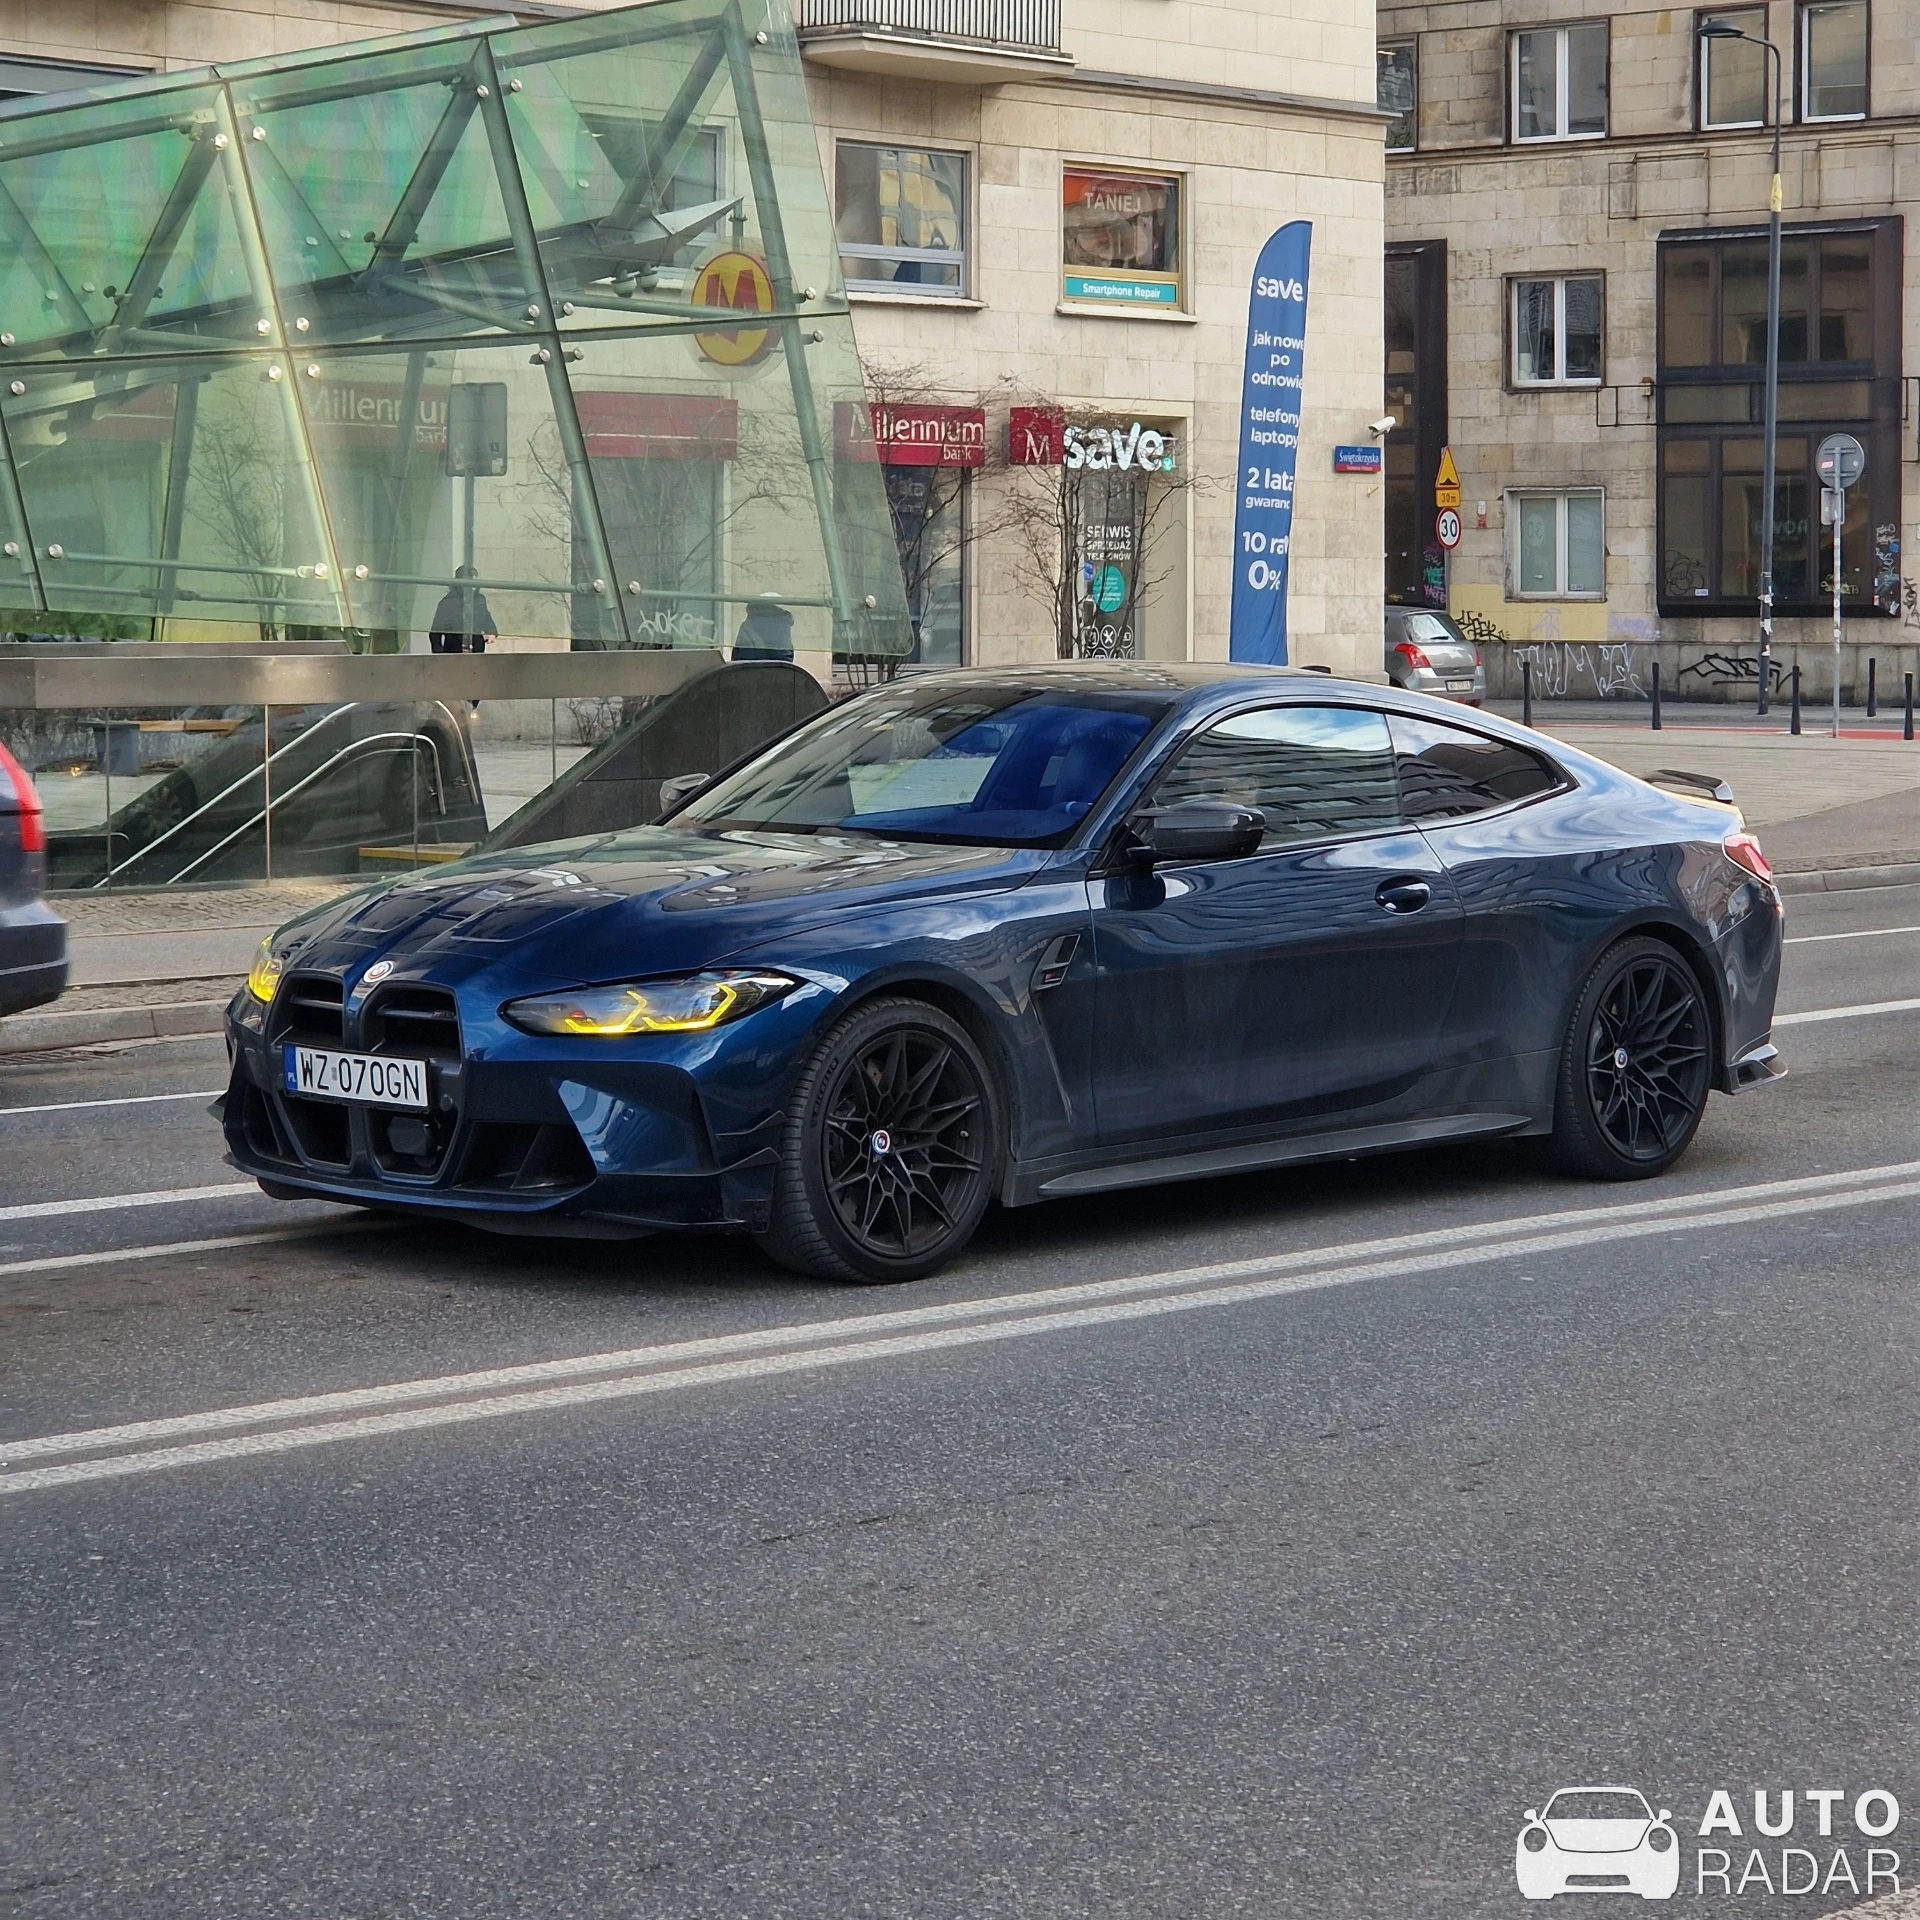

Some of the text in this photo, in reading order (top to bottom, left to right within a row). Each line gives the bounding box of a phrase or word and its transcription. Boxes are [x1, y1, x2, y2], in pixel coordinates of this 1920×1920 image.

[1084, 192, 1141, 213] TANIEJ
[1082, 283, 1161, 299] Smartphone Repair
[1256, 276, 1304, 302] save
[703, 269, 760, 345] M
[1252, 329, 1272, 347] jak
[1270, 353, 1290, 367] po
[1250, 406, 1300, 427] telefony
[1024, 429, 1050, 465] M
[1250, 427, 1298, 449] laptopy
[1246, 466, 1260, 488] 2
[1441, 518, 1458, 538] 30
[1242, 531, 1267, 553] 10
[1248, 560, 1282, 591] 0%
[300, 1051, 421, 1102] WZ 070GN
